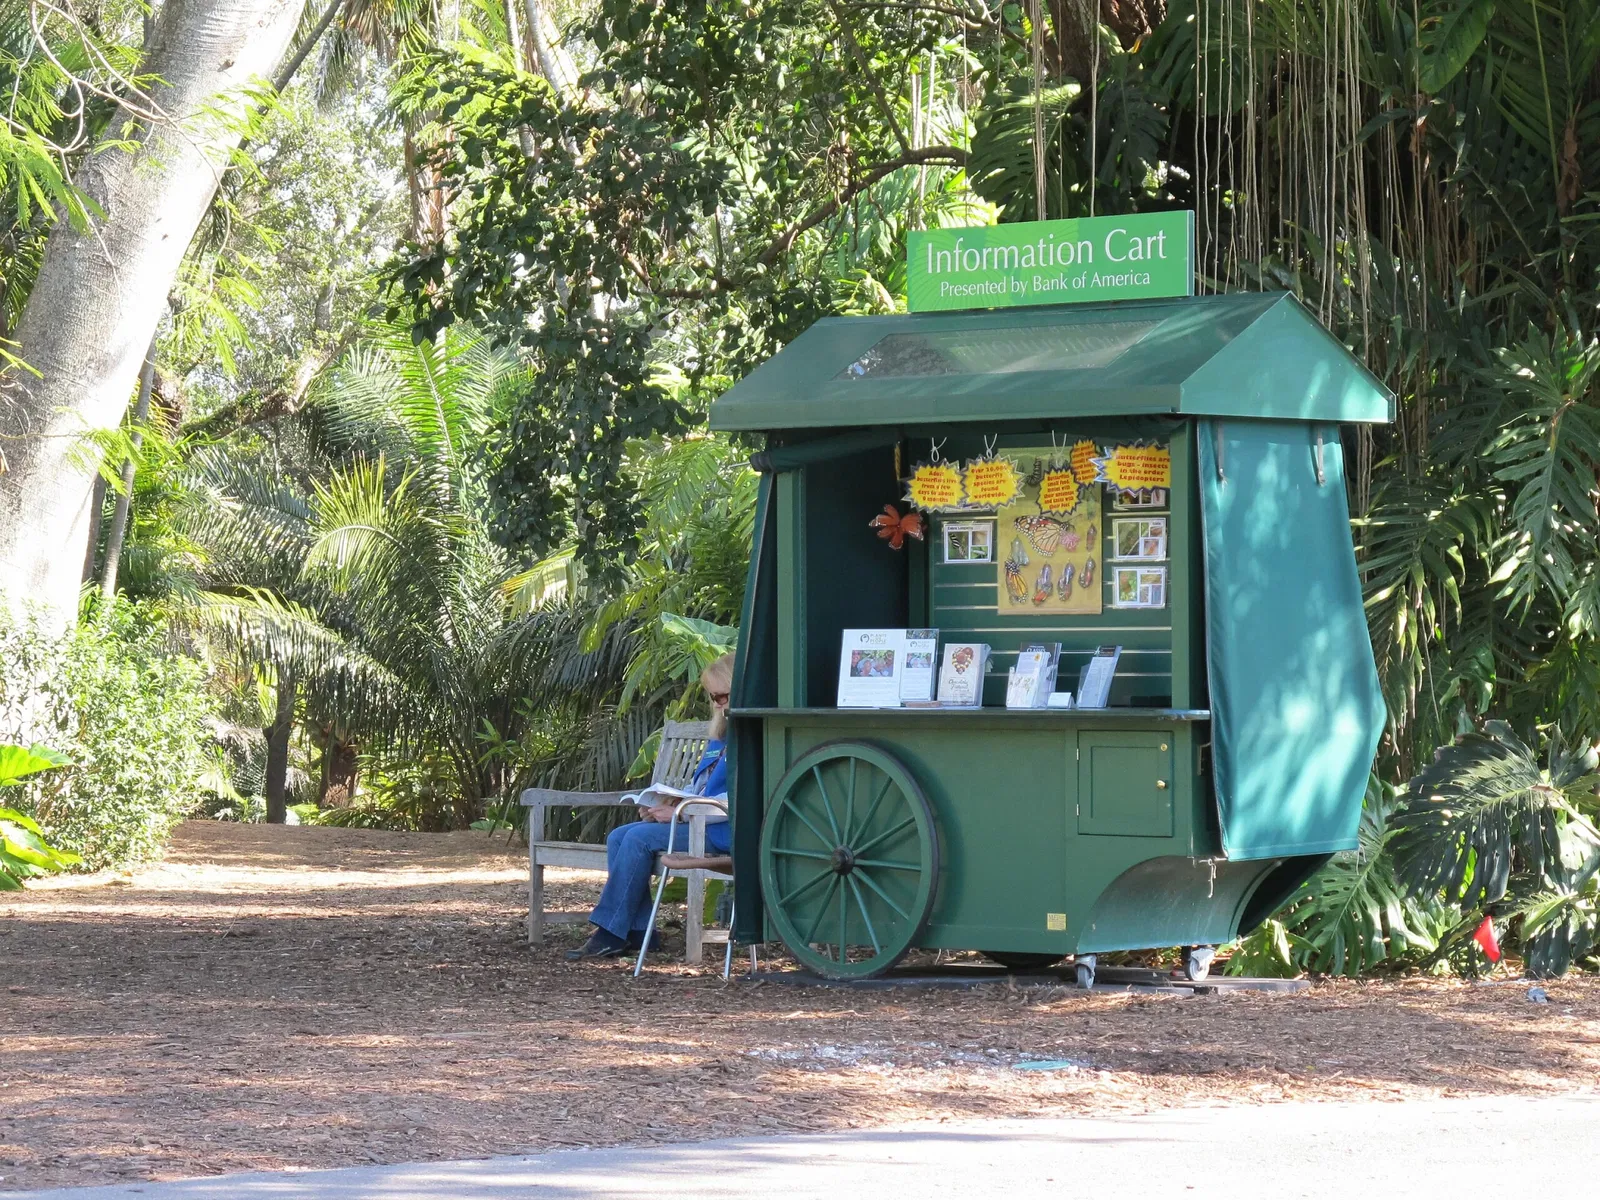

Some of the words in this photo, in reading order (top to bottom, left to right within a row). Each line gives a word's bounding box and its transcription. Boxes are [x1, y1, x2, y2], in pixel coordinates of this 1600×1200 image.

[928, 233, 1093, 274] Information
[1104, 228, 1168, 262] Cart
[940, 276, 1007, 297] Presented
[1011, 275, 1029, 298] by
[1033, 272, 1068, 292] Bank
[1072, 271, 1087, 290] of
[1090, 269, 1151, 289] America
[1116, 454, 1157, 462] Butterflies
[916, 476, 946, 484] butterflies
[975, 472, 1003, 480] butterfly
[1119, 474, 1165, 483] Lepidoptera
